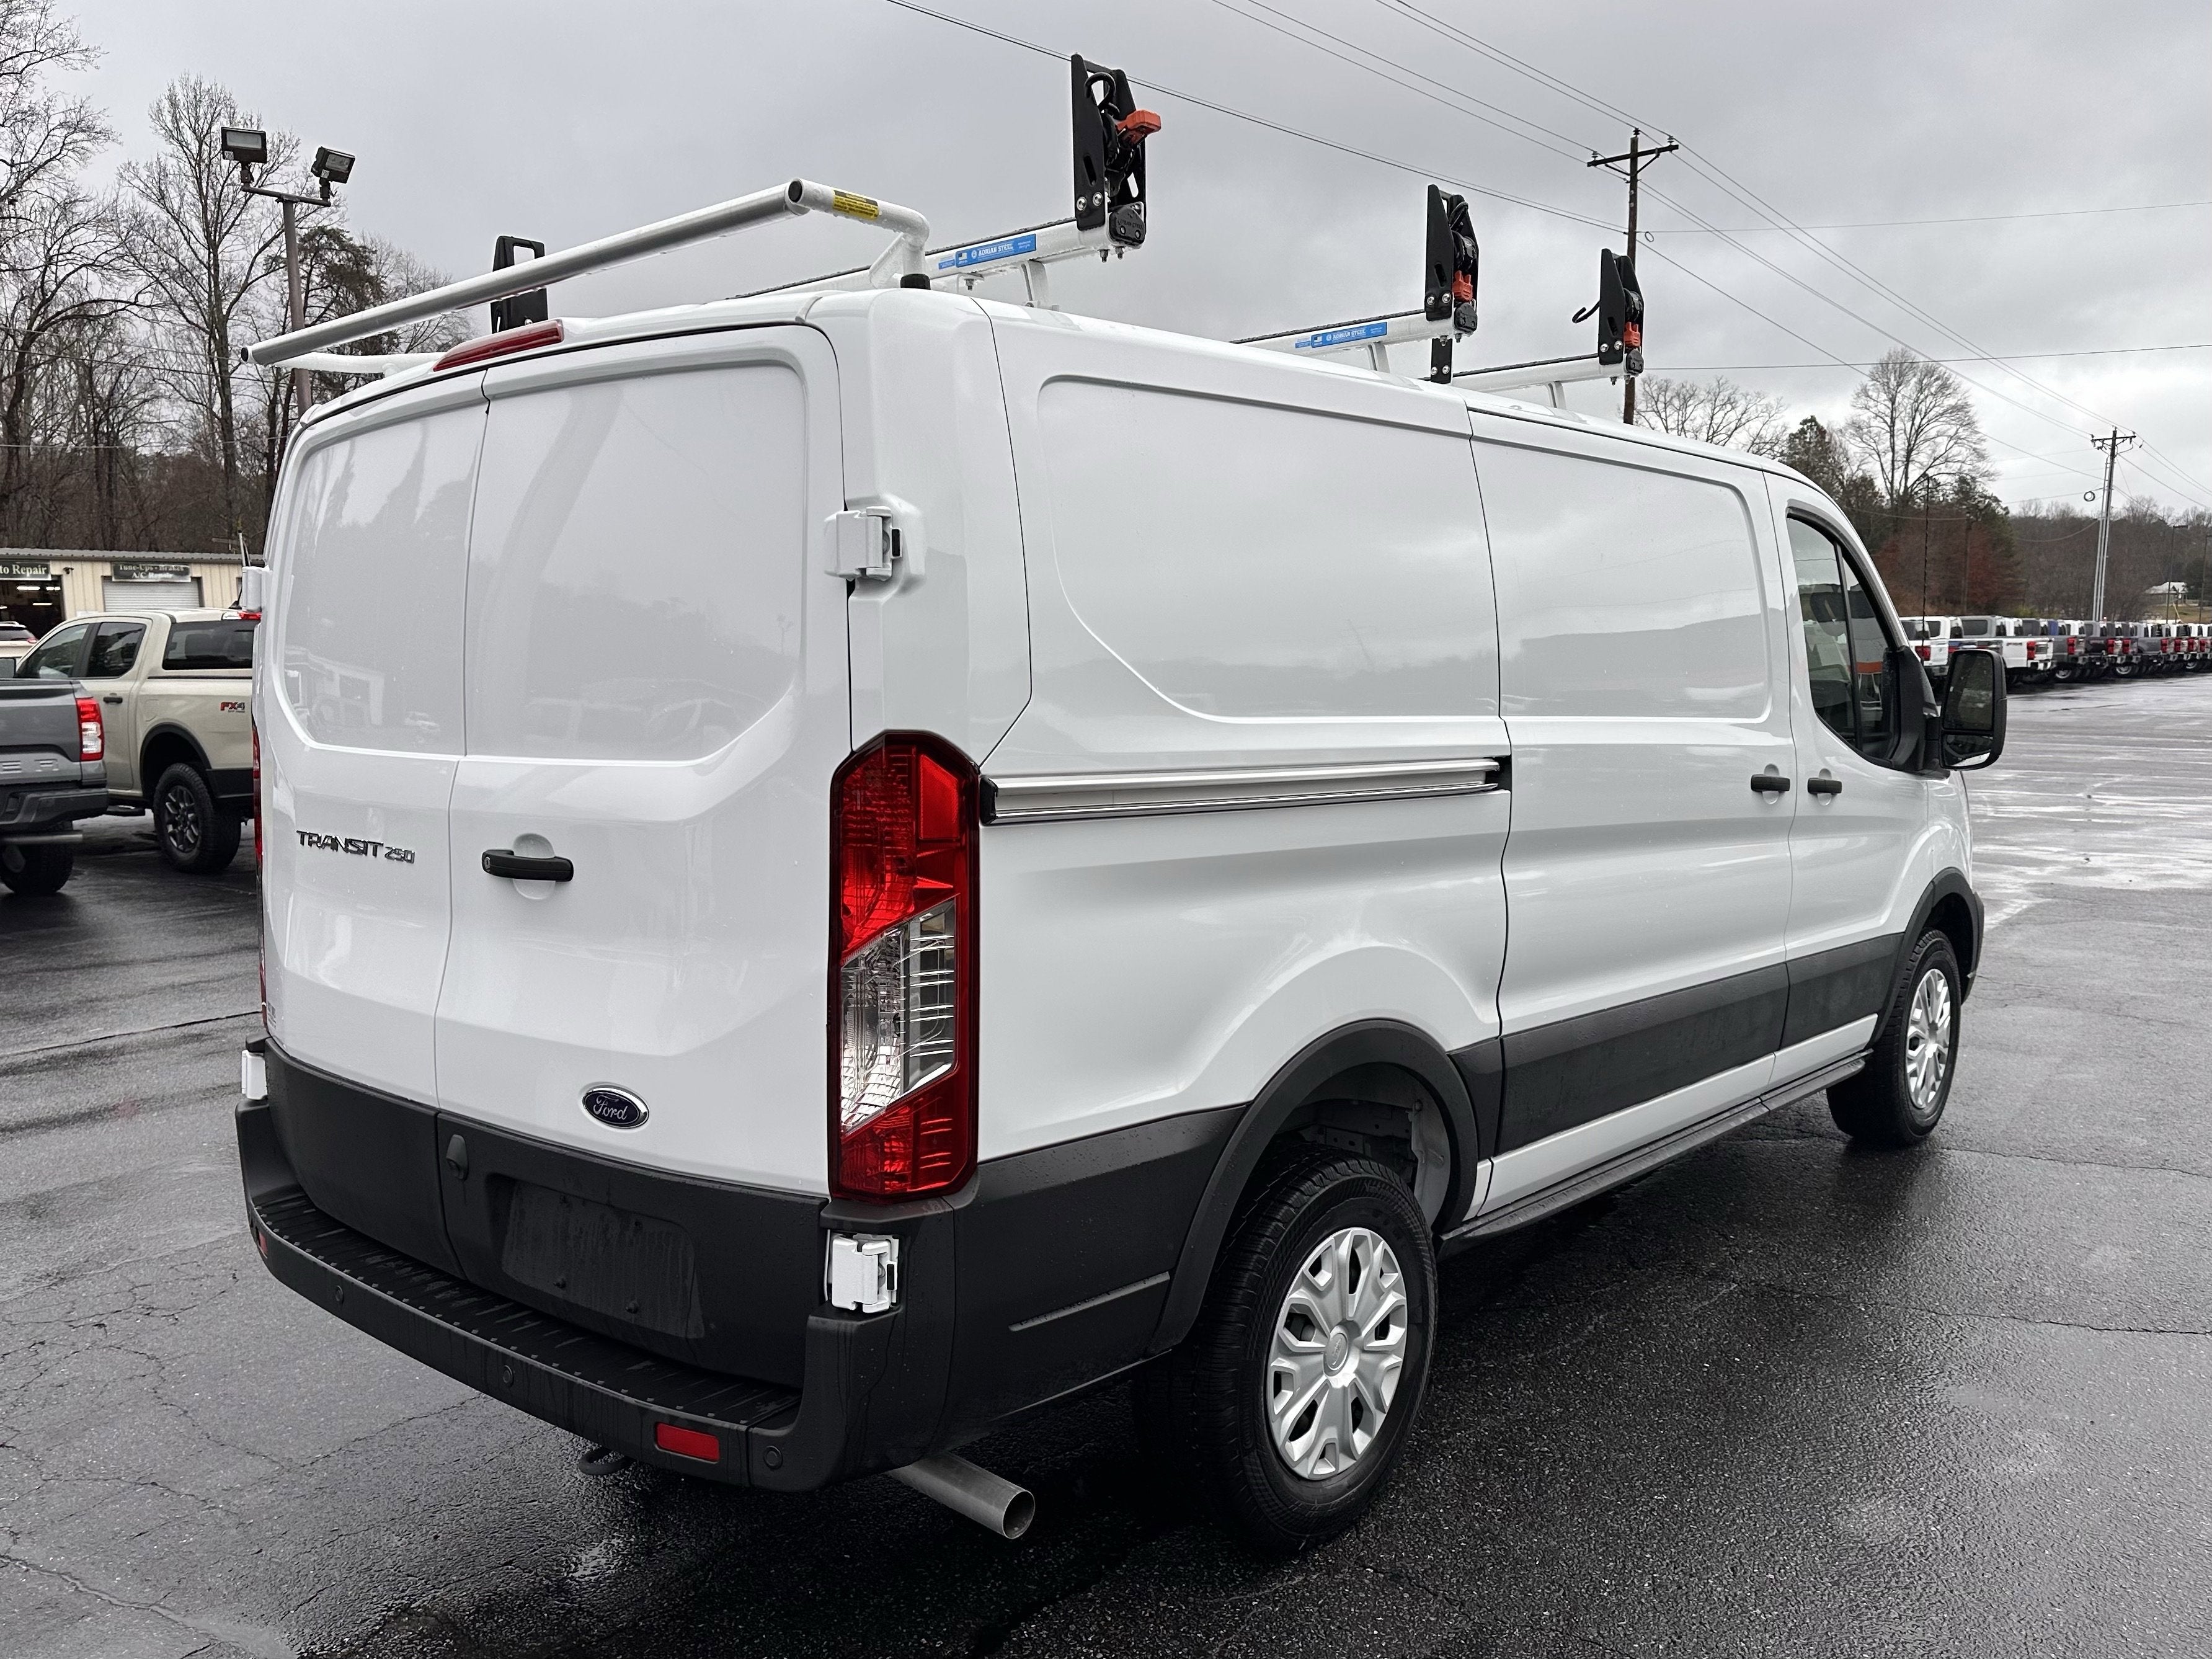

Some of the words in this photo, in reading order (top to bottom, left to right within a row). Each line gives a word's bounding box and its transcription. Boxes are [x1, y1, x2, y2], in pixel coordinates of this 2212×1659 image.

[978, 246, 997, 257] ADRIAN
[998, 244, 1013, 252] STEEL
[12, 564, 47, 577] Repair
[220, 701, 245, 711] FX4
[296, 830, 384, 858] TRANSIT
[384, 846, 415, 864] 250
[593, 1095, 628, 1120] Ford
